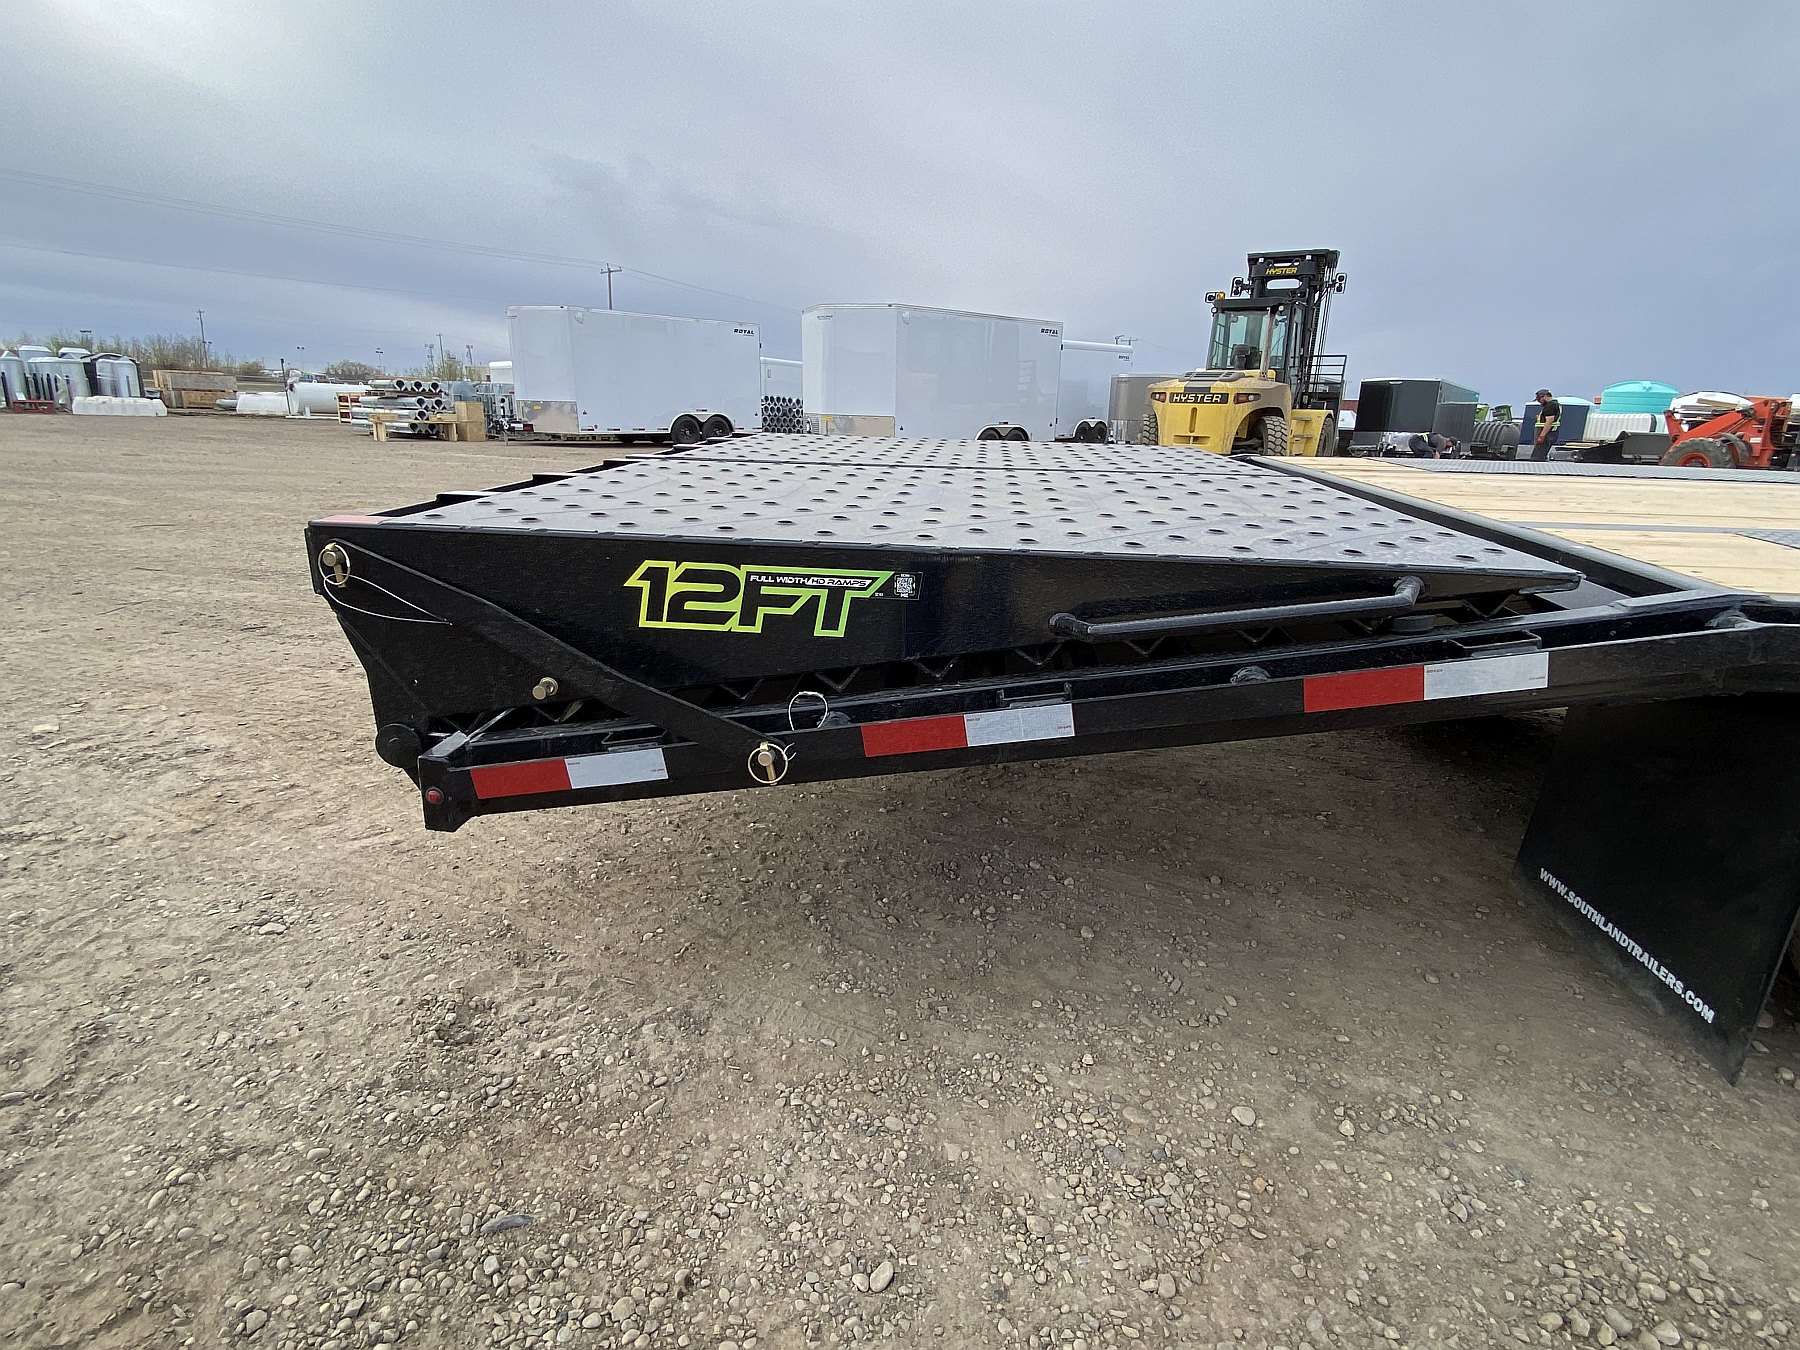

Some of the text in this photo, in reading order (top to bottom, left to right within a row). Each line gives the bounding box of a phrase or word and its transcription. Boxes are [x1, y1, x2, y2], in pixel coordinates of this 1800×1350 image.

[1265, 267, 1298, 275] HYSTER
[1173, 393, 1222, 403] HYSTER
[750, 575, 808, 584] FULL WIDTH
[811, 577, 868, 588] HD RAMPS
[624, 560, 895, 637] 12FT
[1540, 867, 1715, 1024] WWW.SOUTHLANDTRAILERS.COM
